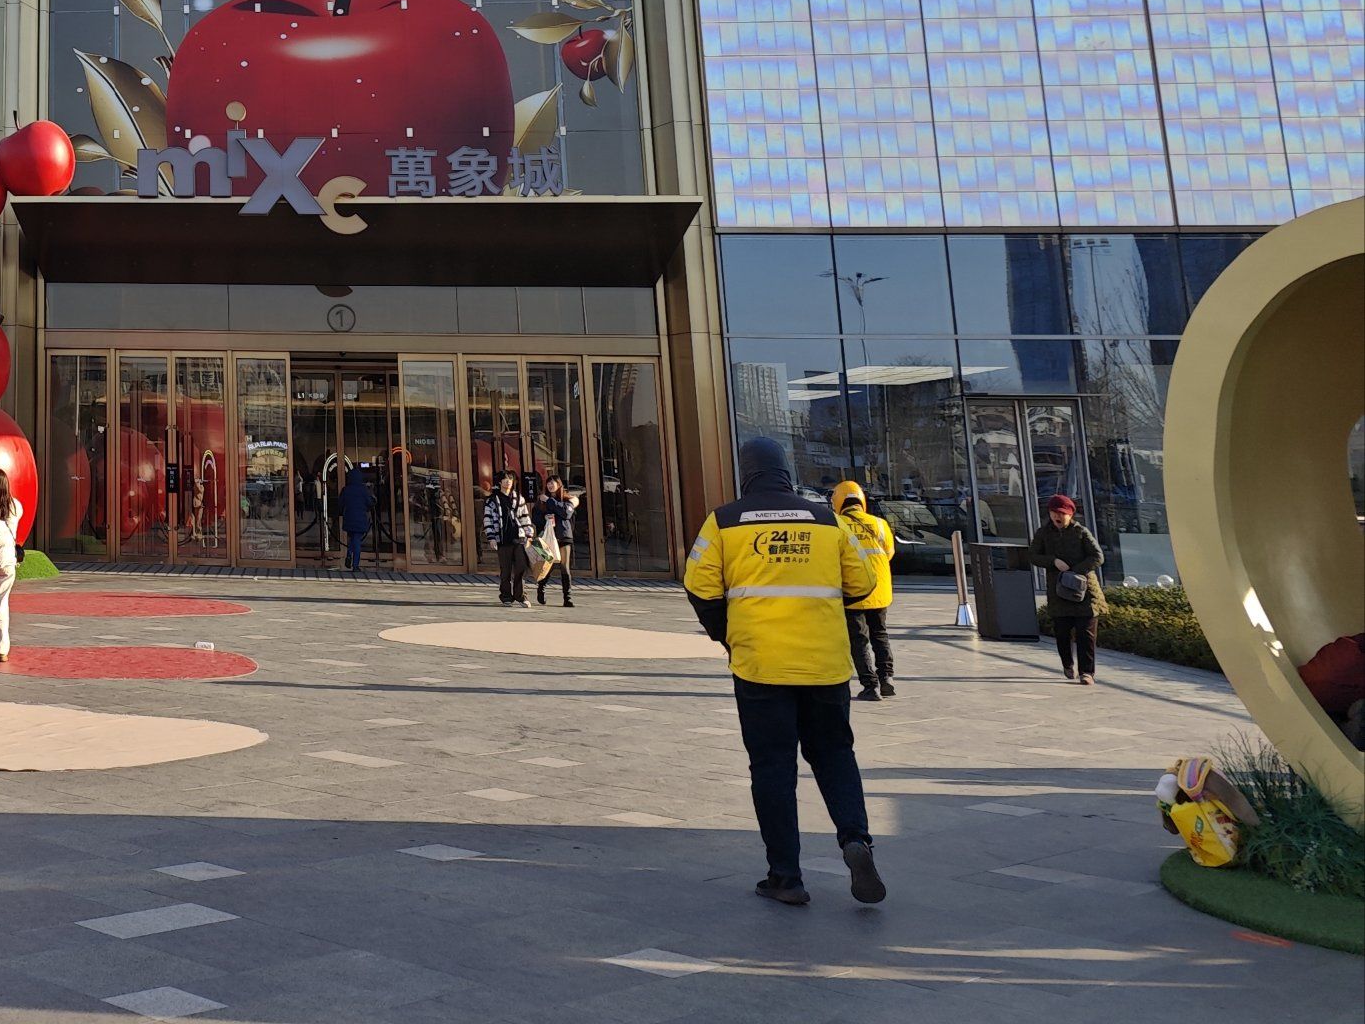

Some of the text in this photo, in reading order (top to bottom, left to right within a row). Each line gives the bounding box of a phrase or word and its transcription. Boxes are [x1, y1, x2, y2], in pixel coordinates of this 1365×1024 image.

[385, 146, 565, 198] 萬象城
[770, 530, 812, 544] 24小时
[768, 543, 811, 555] 看病买药
